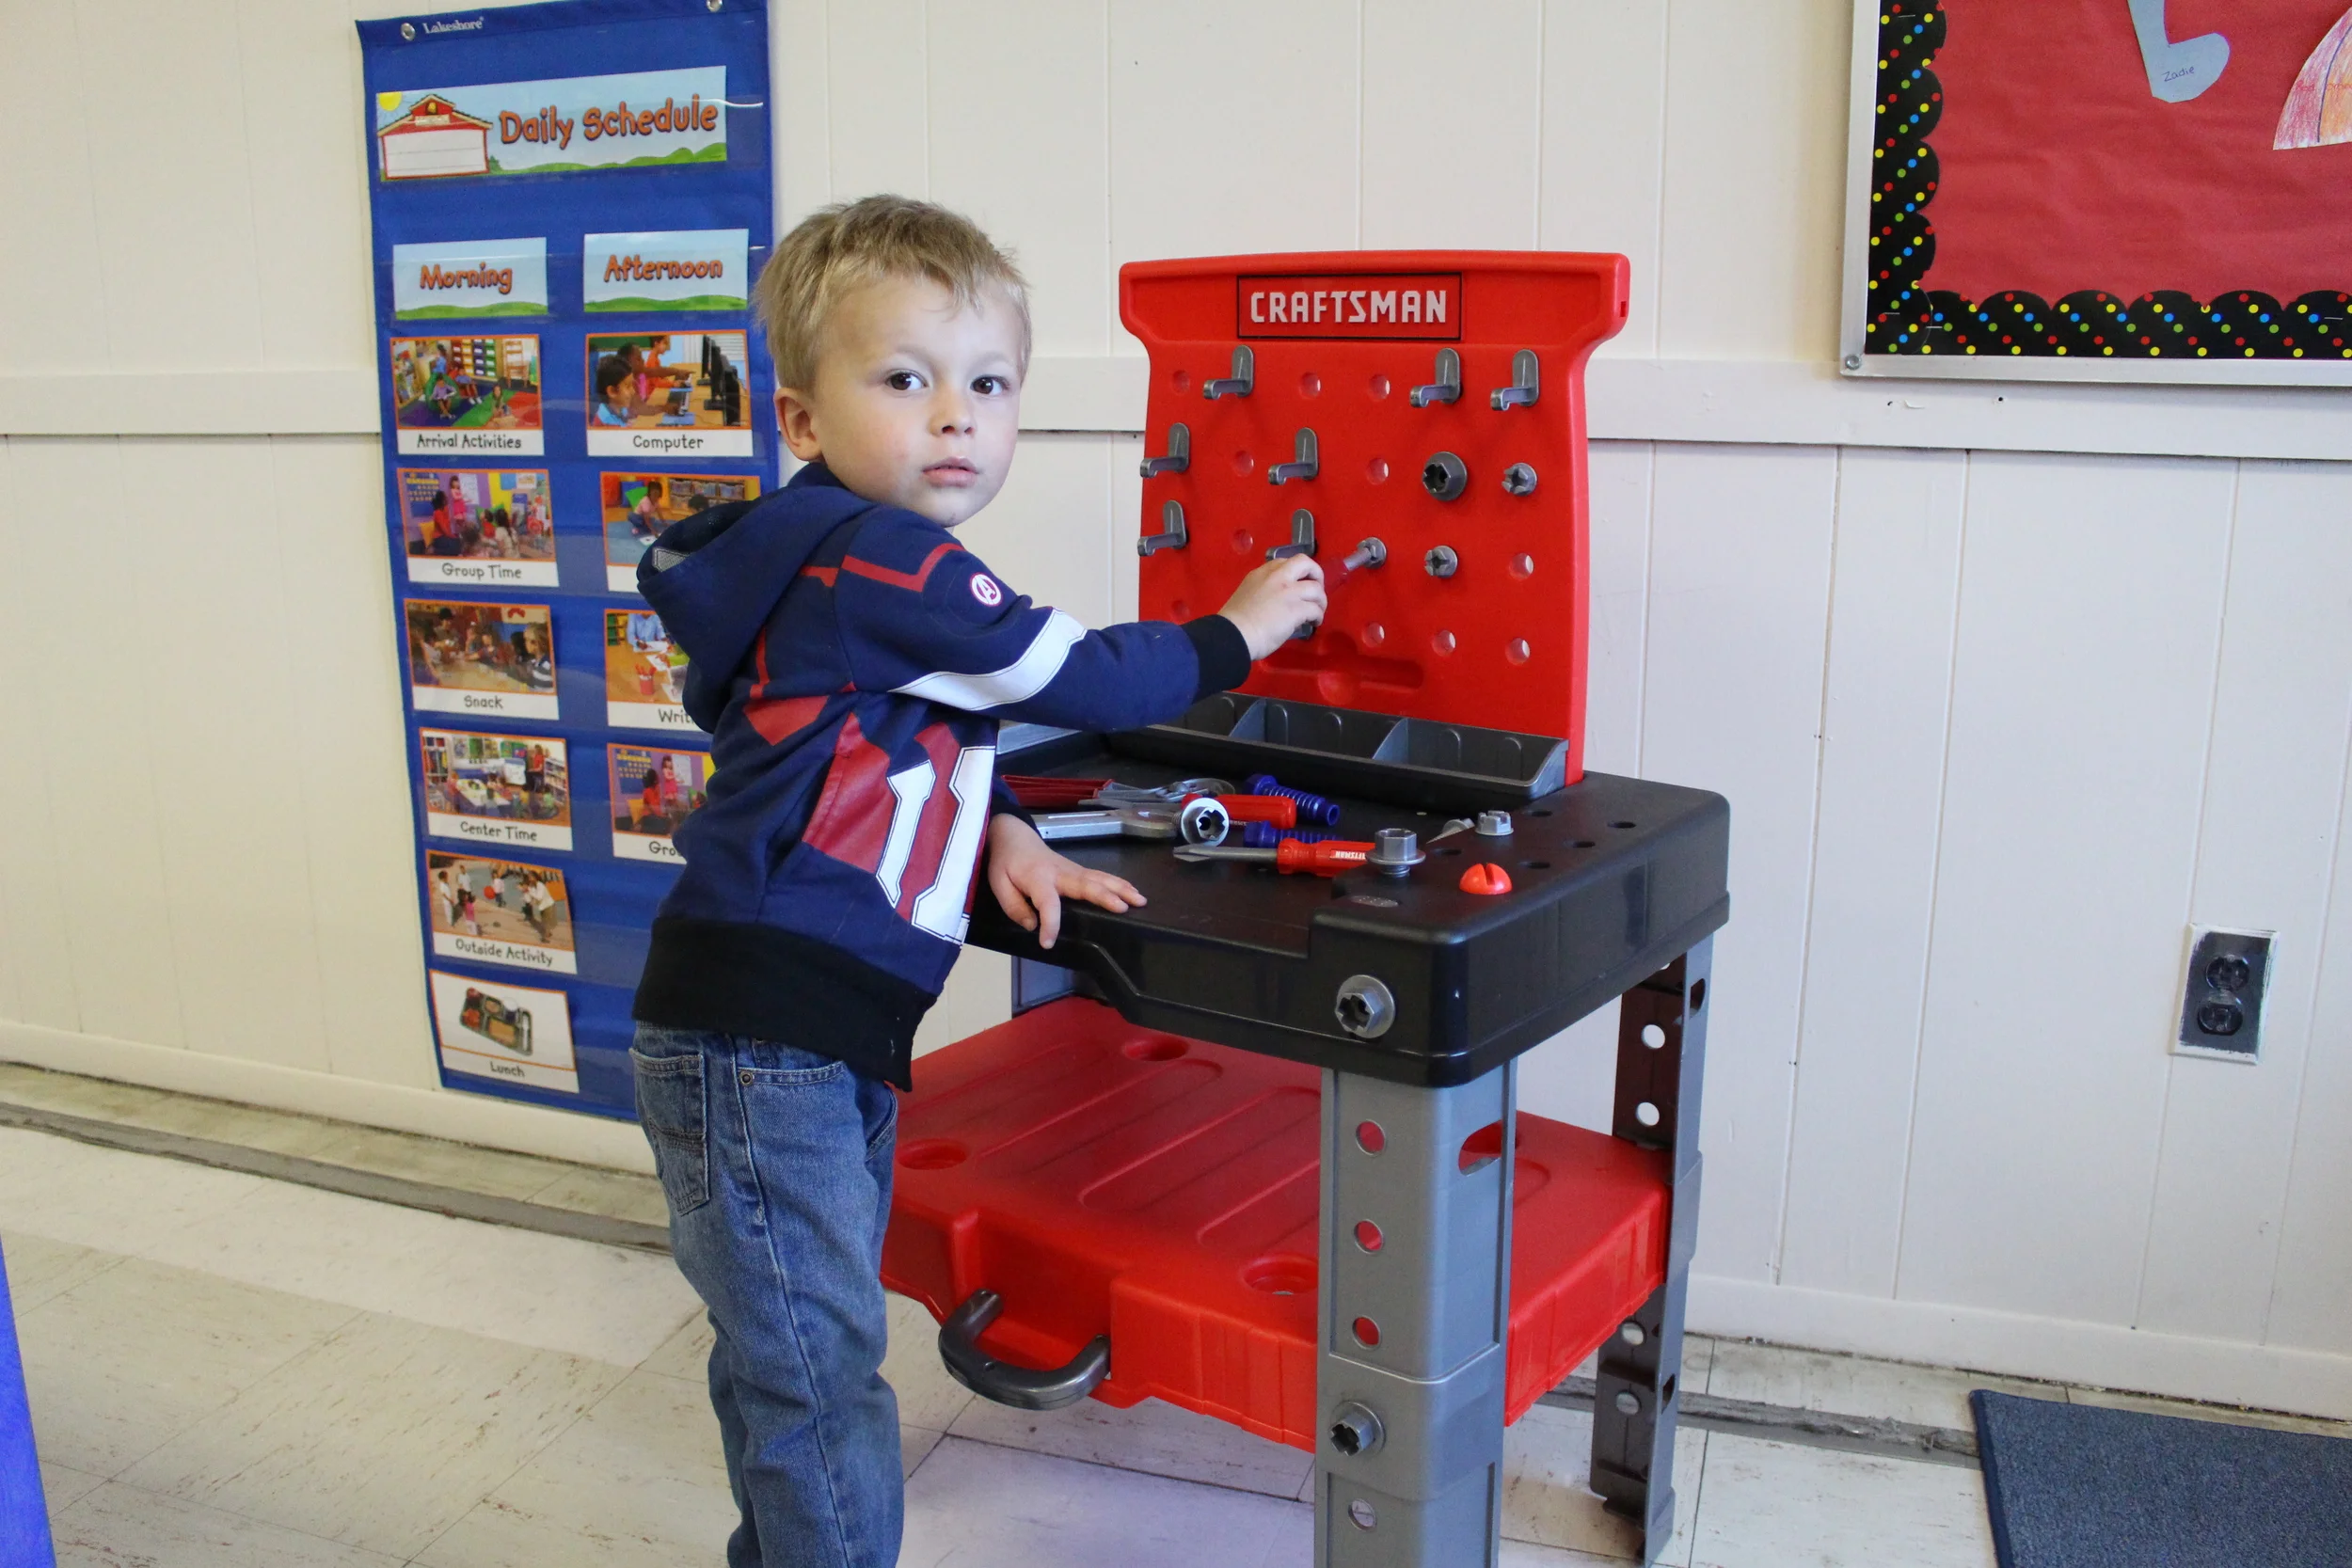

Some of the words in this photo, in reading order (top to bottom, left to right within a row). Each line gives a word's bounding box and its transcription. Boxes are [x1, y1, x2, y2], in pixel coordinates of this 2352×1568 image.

[2161, 66, 2195, 82] Zadie
[499, 104, 574, 149] Daily
[582, 93, 719, 140] Schedule
[604, 254, 723, 282] Afternoon
[420, 261, 514, 294] Morning
[1250, 290, 1447, 323] CRAFTSMAN
[417, 435, 458, 449] Arrival
[462, 434, 522, 450] Activities
[632, 436, 705, 452] Computer
[441, 562, 485, 579] Group
[488, 564, 522, 579] Time
[464, 695, 504, 710] Snack
[659, 709, 691, 723] Writ
[460, 821, 502, 838] Center
[504, 827, 538, 842] Time
[649, 841, 678, 856] Gro
[455, 939, 502, 958] Outside
[506, 948, 553, 967] Activity
[490, 1061, 525, 1077] Lunch
